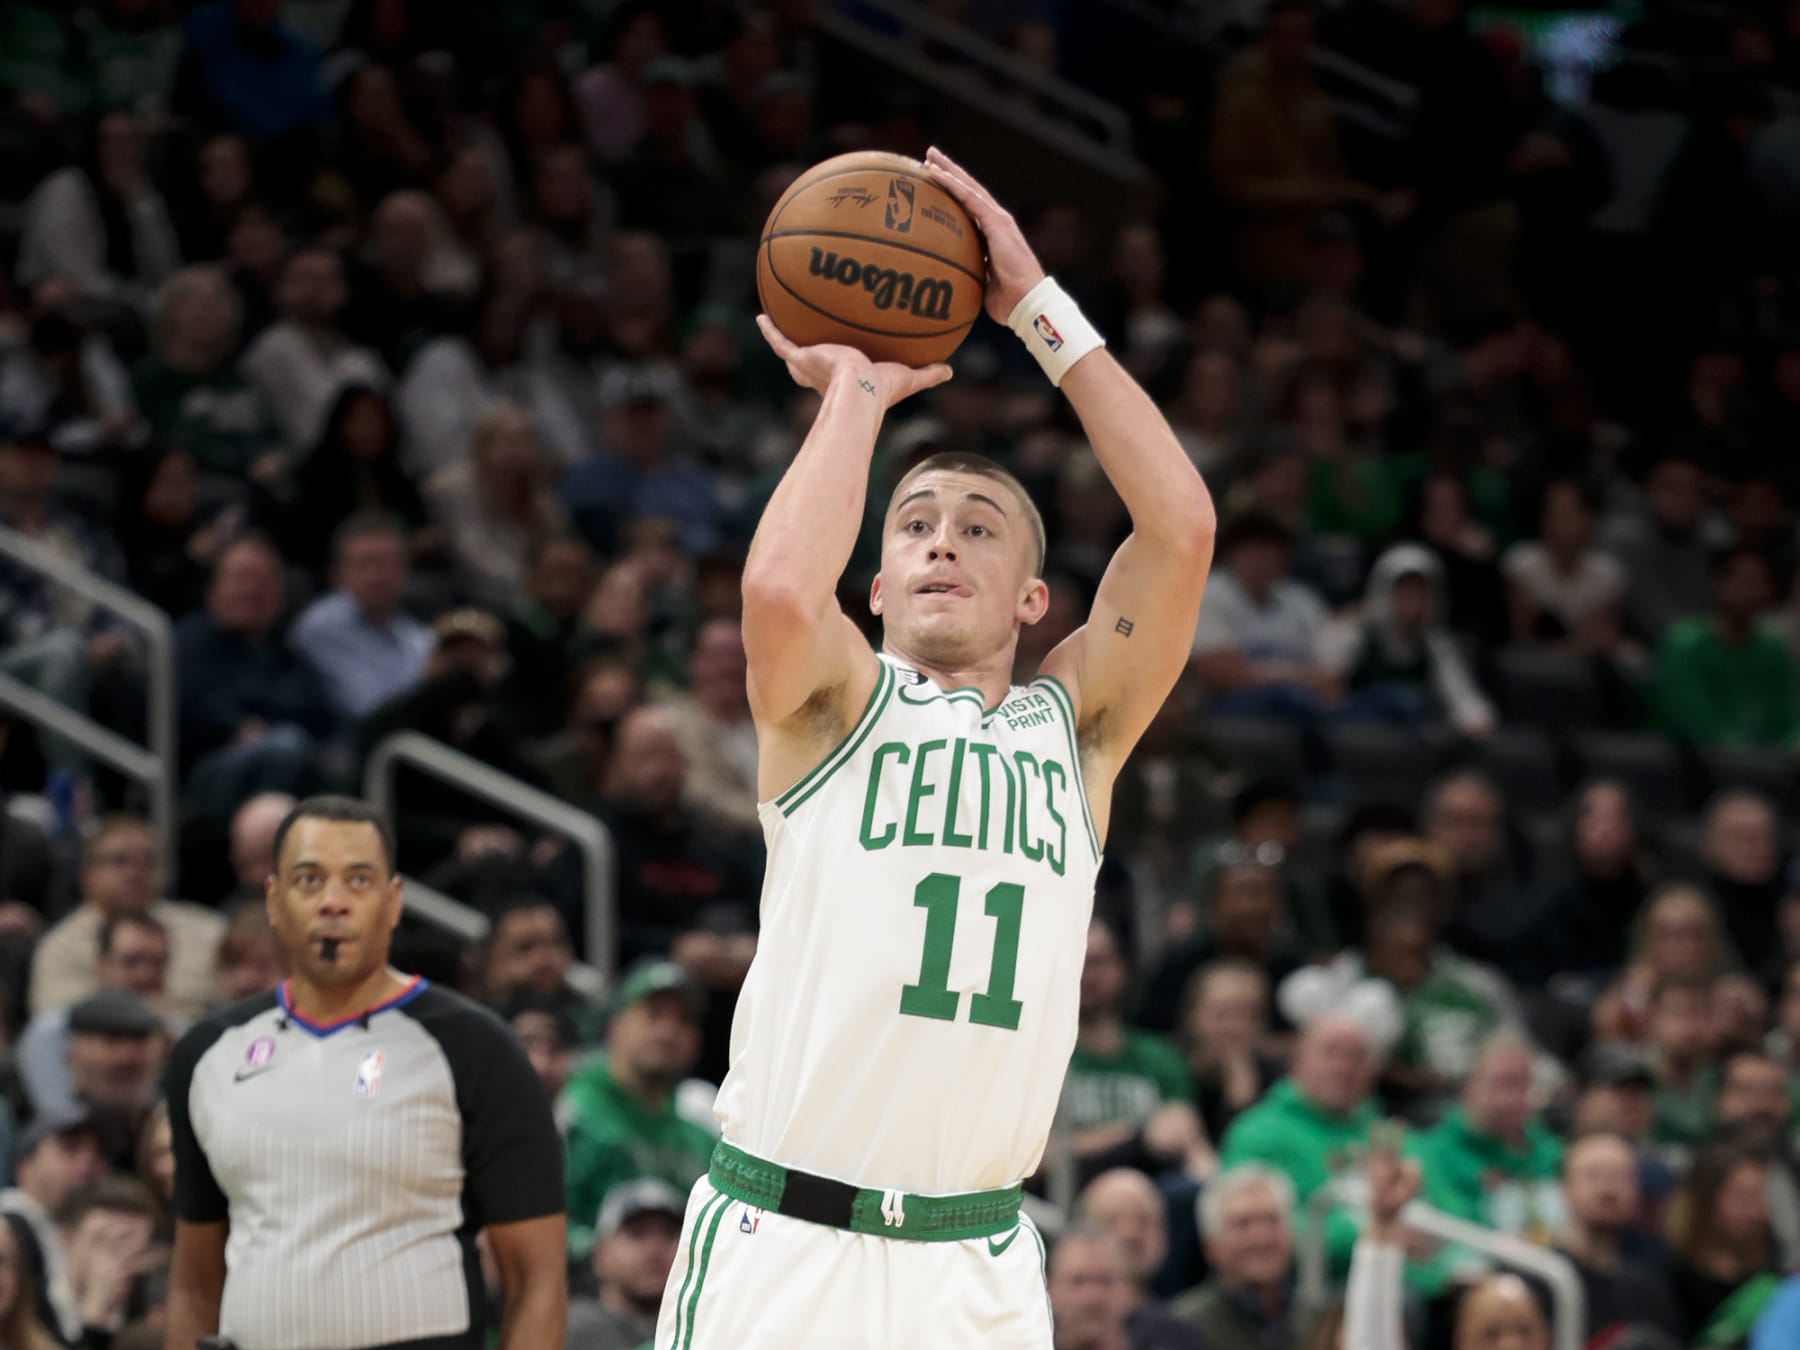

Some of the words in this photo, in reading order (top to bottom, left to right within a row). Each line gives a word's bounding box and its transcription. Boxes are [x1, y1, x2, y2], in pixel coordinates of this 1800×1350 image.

[808, 246, 954, 321] Wilson
[997, 694, 1050, 719] VISTA
[1007, 707, 1056, 731] PRINT
[858, 737, 1067, 877] CELTICS
[899, 872, 1026, 1031] 11
